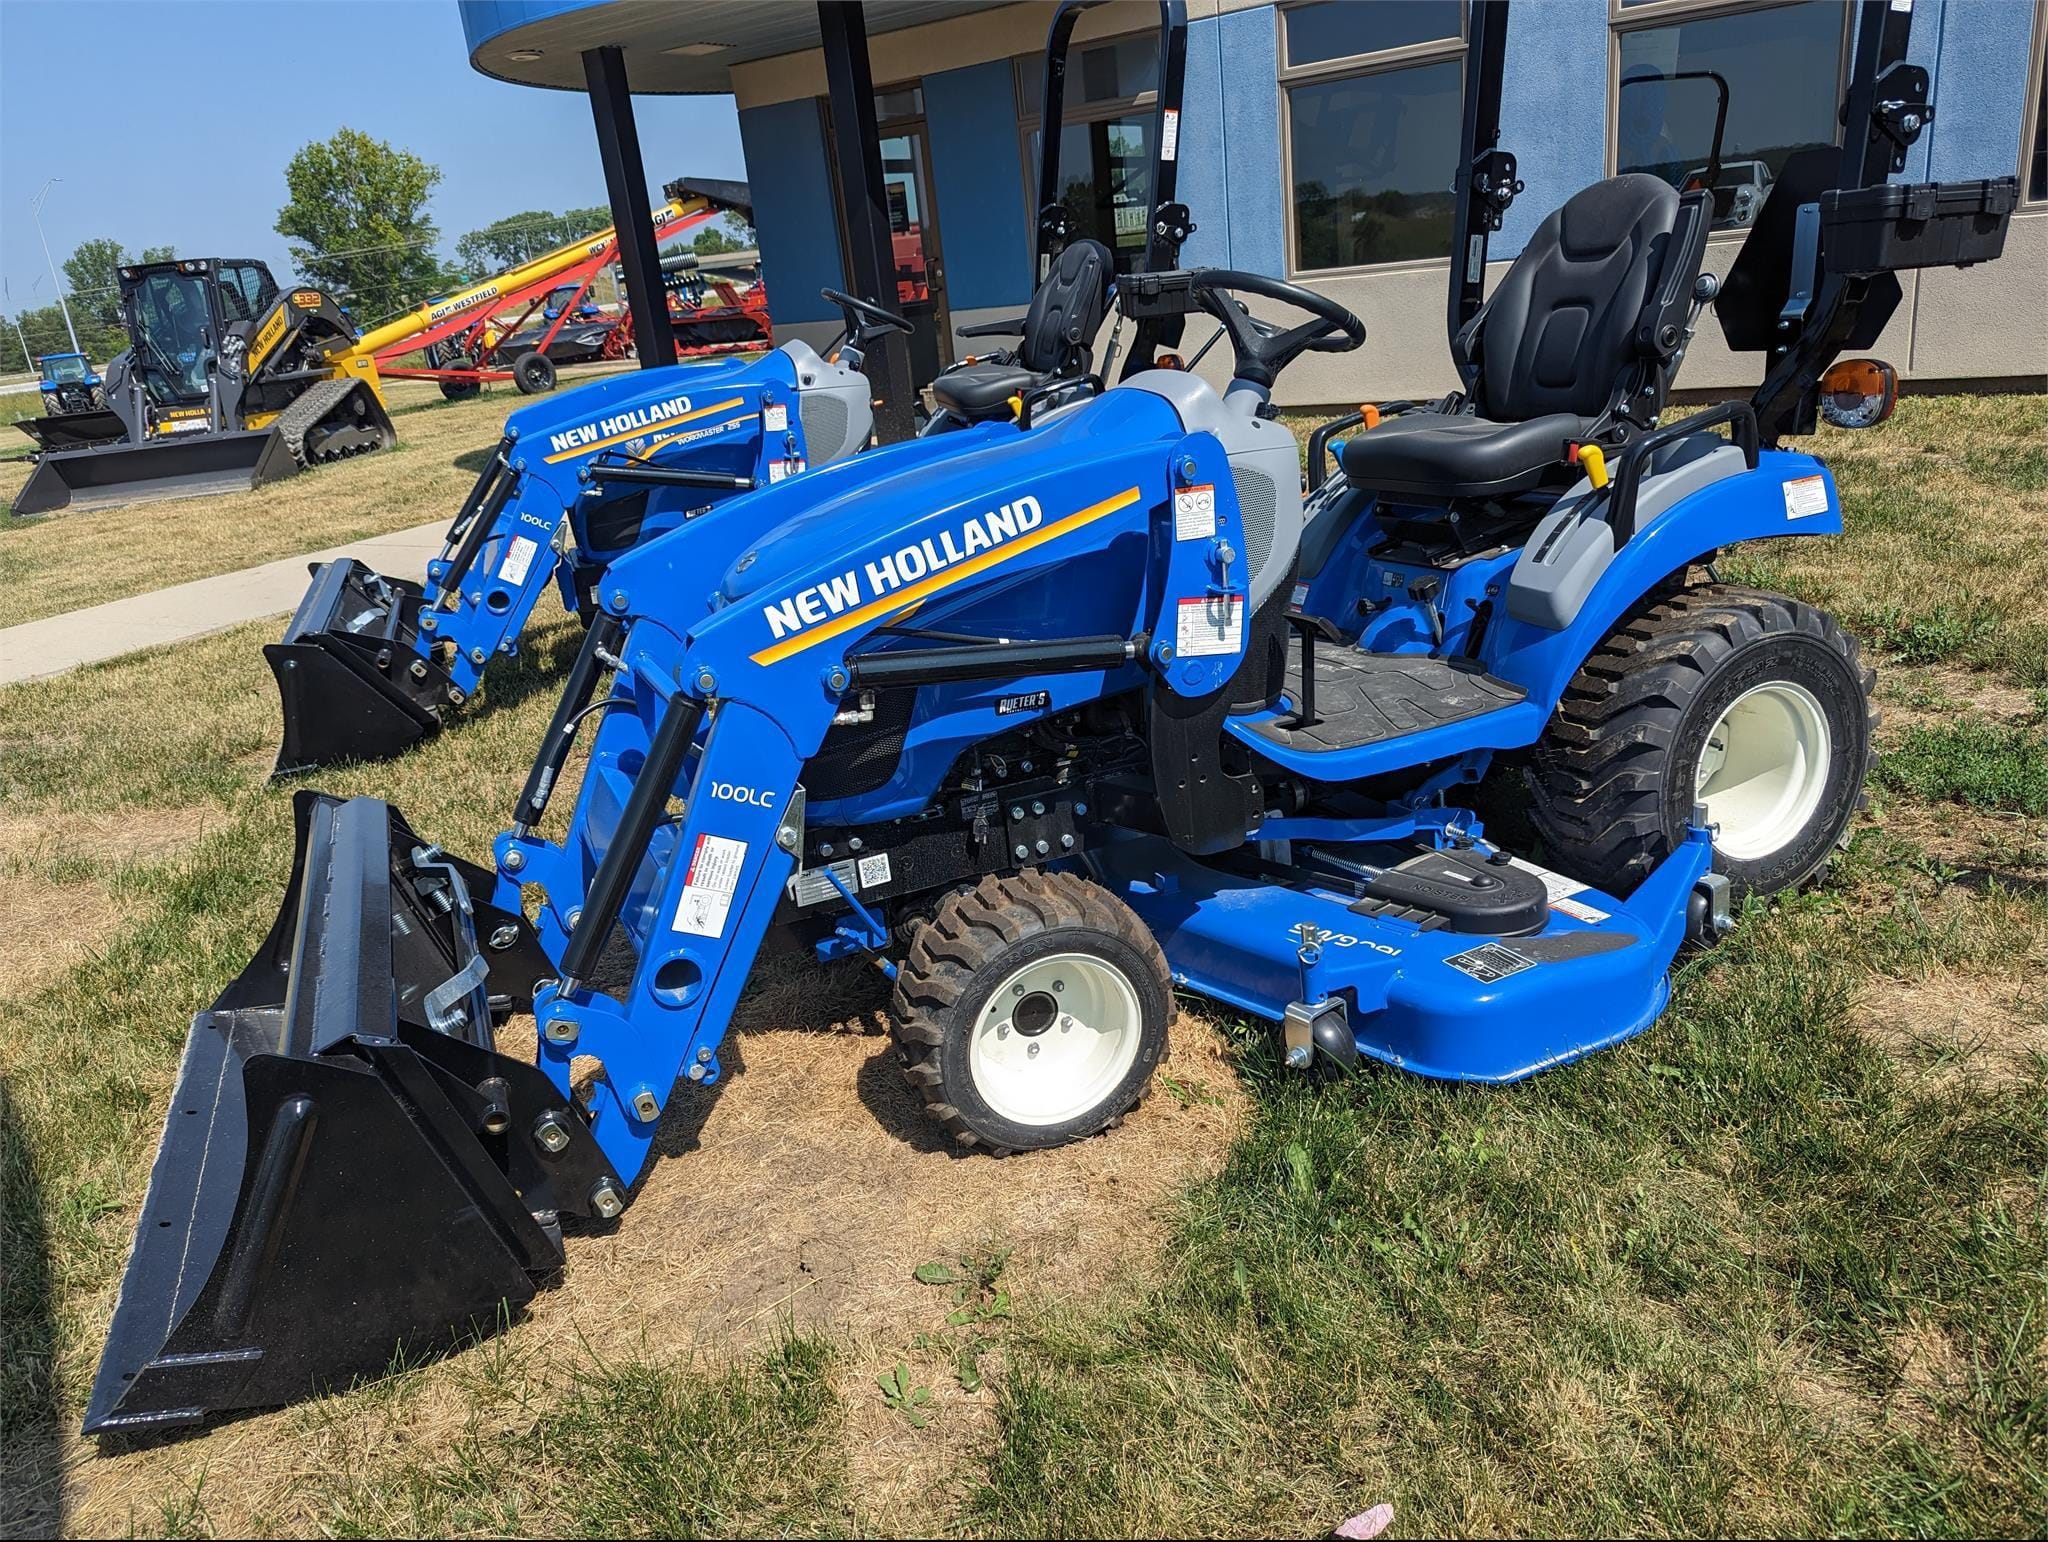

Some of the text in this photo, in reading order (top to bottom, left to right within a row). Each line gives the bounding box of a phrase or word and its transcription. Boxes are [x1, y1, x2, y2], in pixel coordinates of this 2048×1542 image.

[654, 213, 666, 225] GI
[431, 287, 498, 320] AGI WESTFIELD
[263, 316, 284, 342] HOLLAND
[170, 408, 211, 418] NEW HOLLA
[550, 396, 692, 452] NEW HOLLAND
[677, 425, 725, 446] WORKMASTER
[520, 512, 552, 531] 100LC
[763, 495, 1043, 640] NEW HOLLAND
[999, 692, 1046, 713] RUETER'S
[711, 781, 776, 808] 100LC
